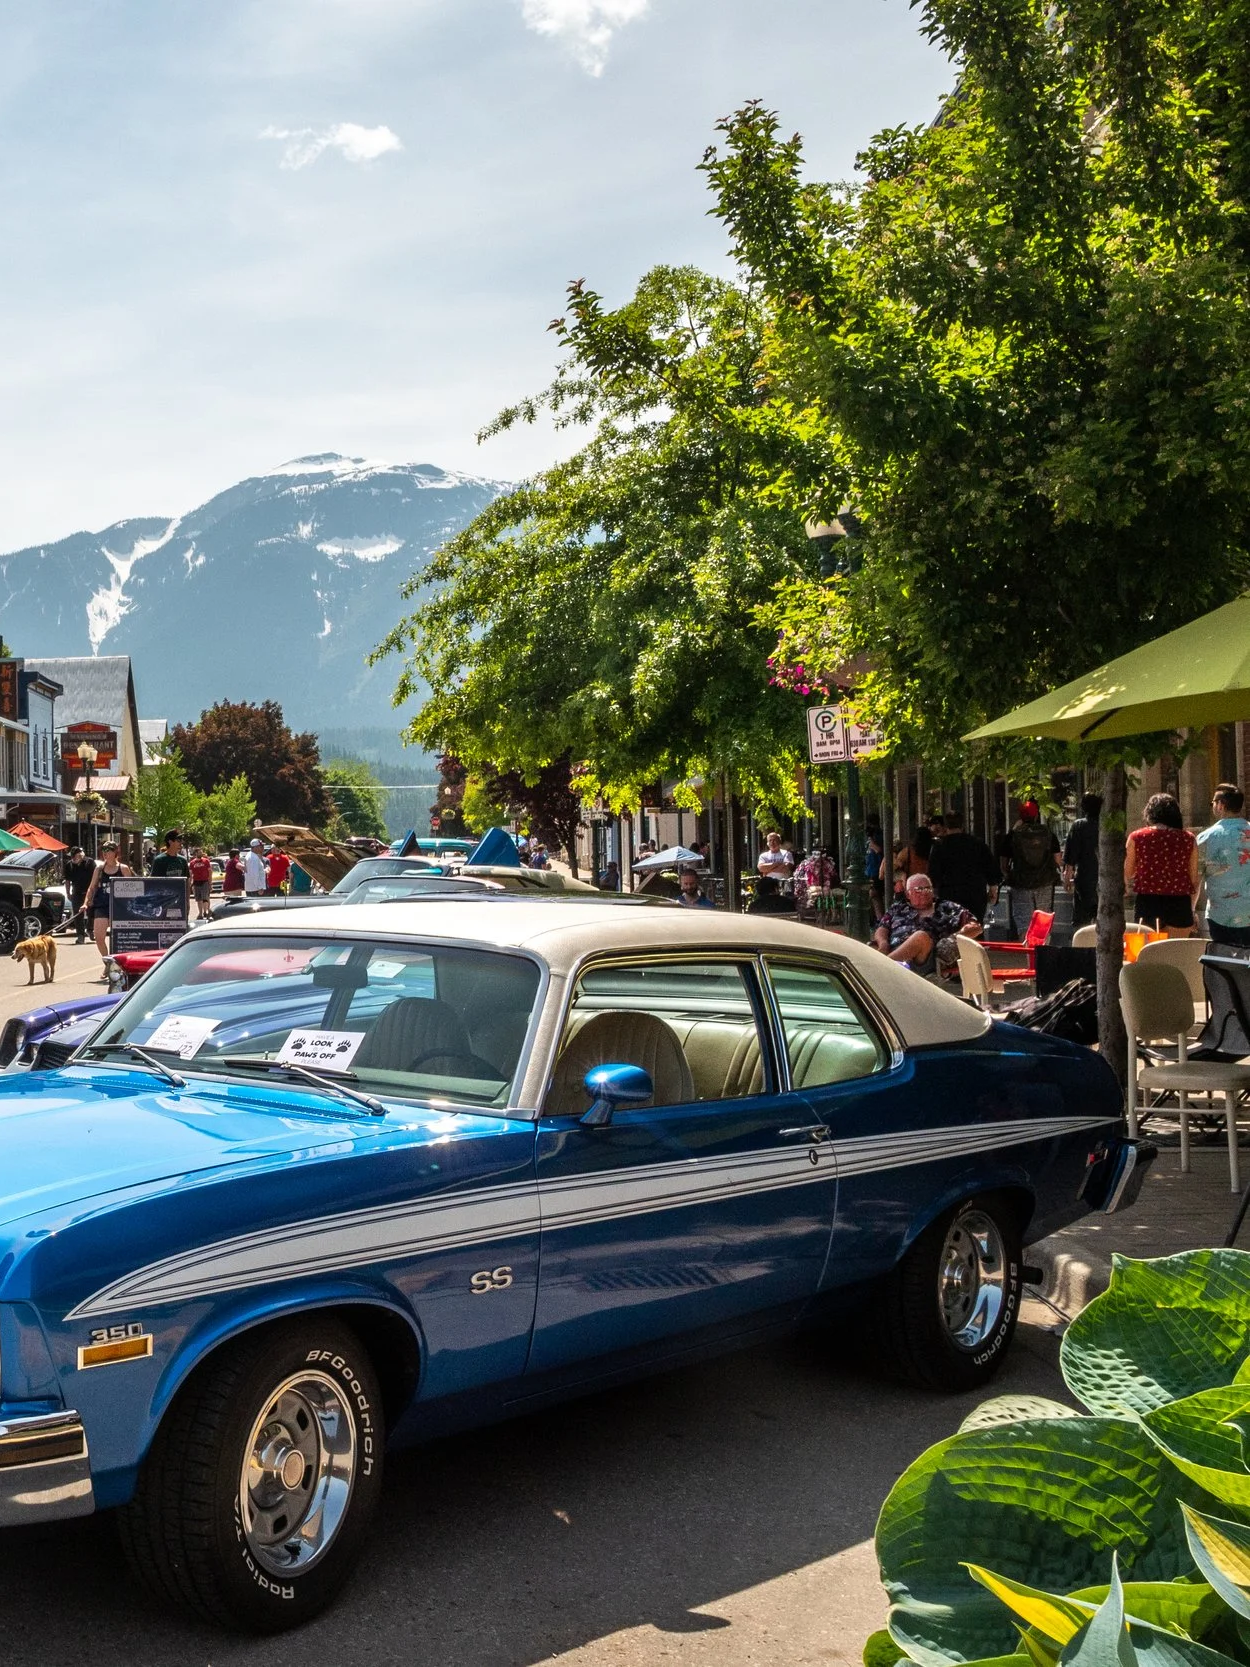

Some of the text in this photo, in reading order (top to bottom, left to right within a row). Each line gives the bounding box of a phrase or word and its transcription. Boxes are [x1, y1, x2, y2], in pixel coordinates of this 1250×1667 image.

[826, 732, 835, 740] HR
[319, 1052, 336, 1060] OFF
[470, 1266, 513, 1295] SS
[974, 1262, 1018, 1366] BFGoodrich
[90, 1322, 143, 1345] 350
[305, 1350, 374, 1476] BFGoodrich
[242, 1548, 294, 1599] Radial
